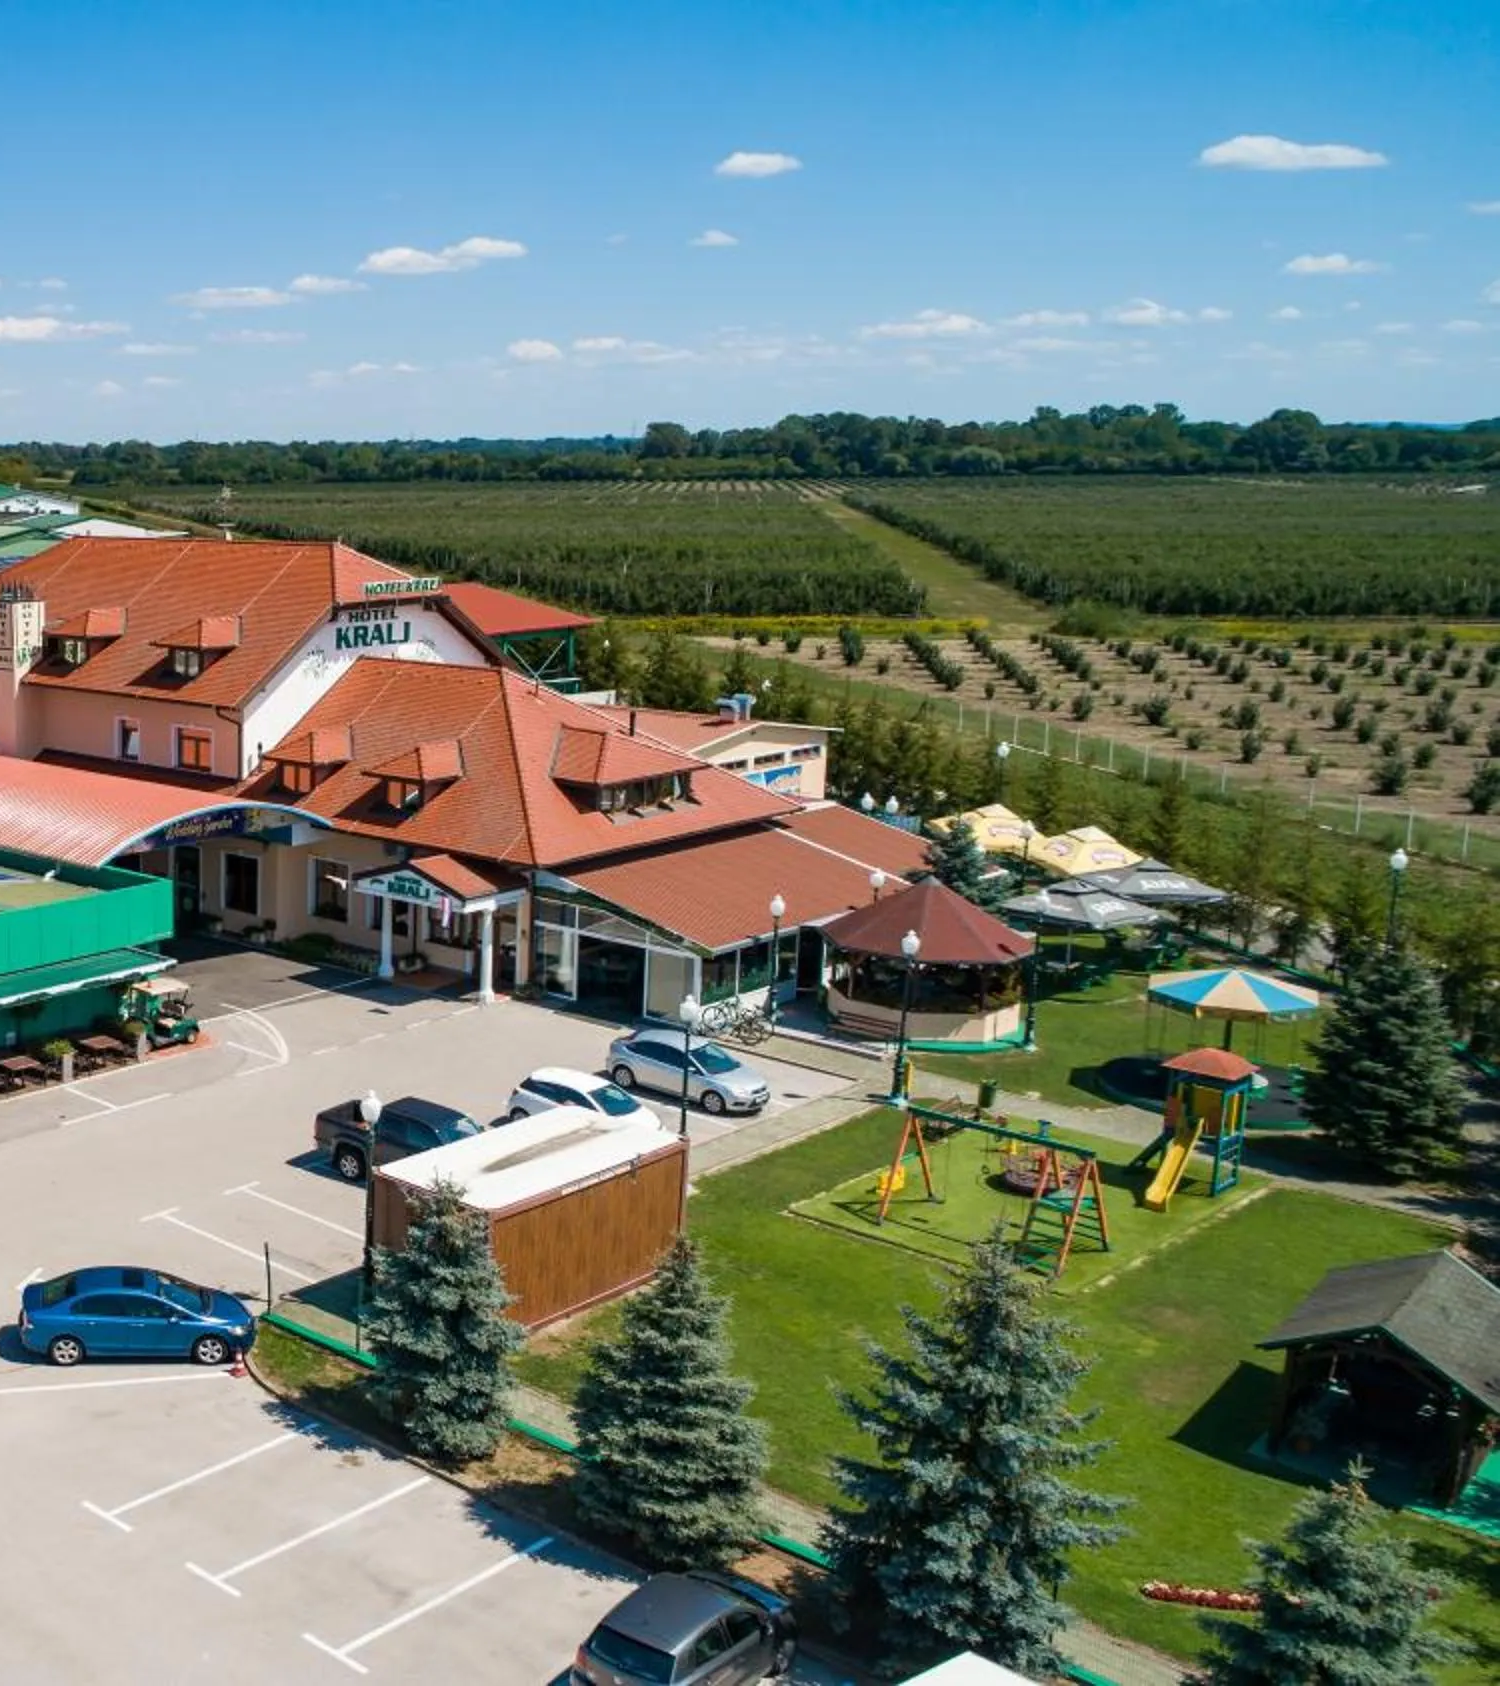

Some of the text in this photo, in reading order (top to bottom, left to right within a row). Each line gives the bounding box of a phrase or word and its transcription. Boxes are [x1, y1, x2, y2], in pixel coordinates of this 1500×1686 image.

[349, 607, 398, 623] HOTEL
[335, 621, 412, 650] KRALJ
[387, 880, 431, 901] KRALJ
